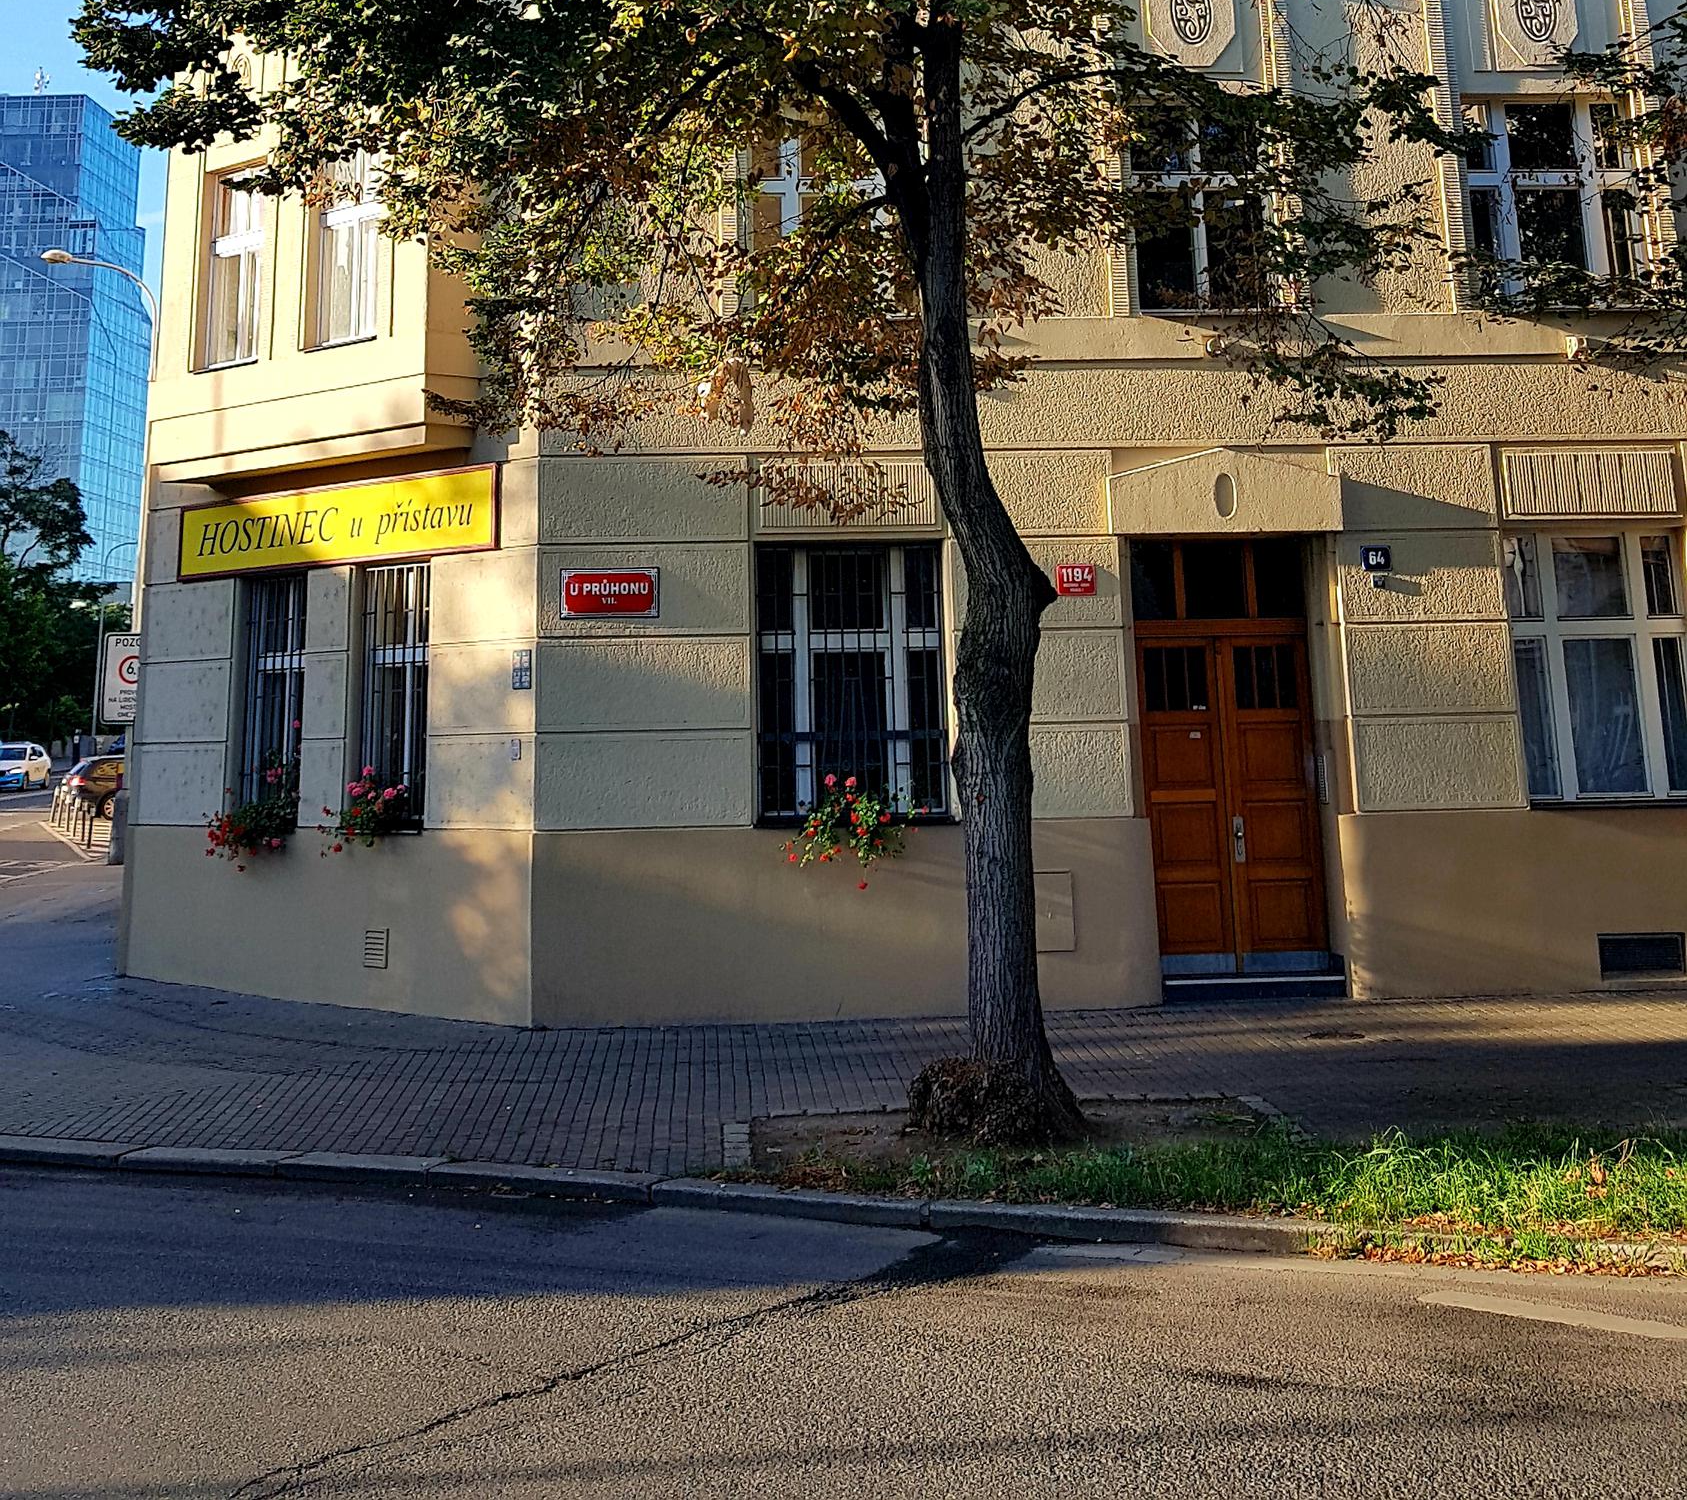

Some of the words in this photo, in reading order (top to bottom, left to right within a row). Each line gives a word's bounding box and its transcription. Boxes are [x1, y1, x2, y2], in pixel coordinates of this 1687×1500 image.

[196, 506, 339, 557] HOSTINEC
[350, 516, 363, 538] u
[374, 499, 473, 545] přístavu
[1368, 551, 1385, 565] 64
[1061, 567, 1093, 582] 1194
[570, 583, 579, 596] U
[582, 579, 649, 596] PRŮHONU
